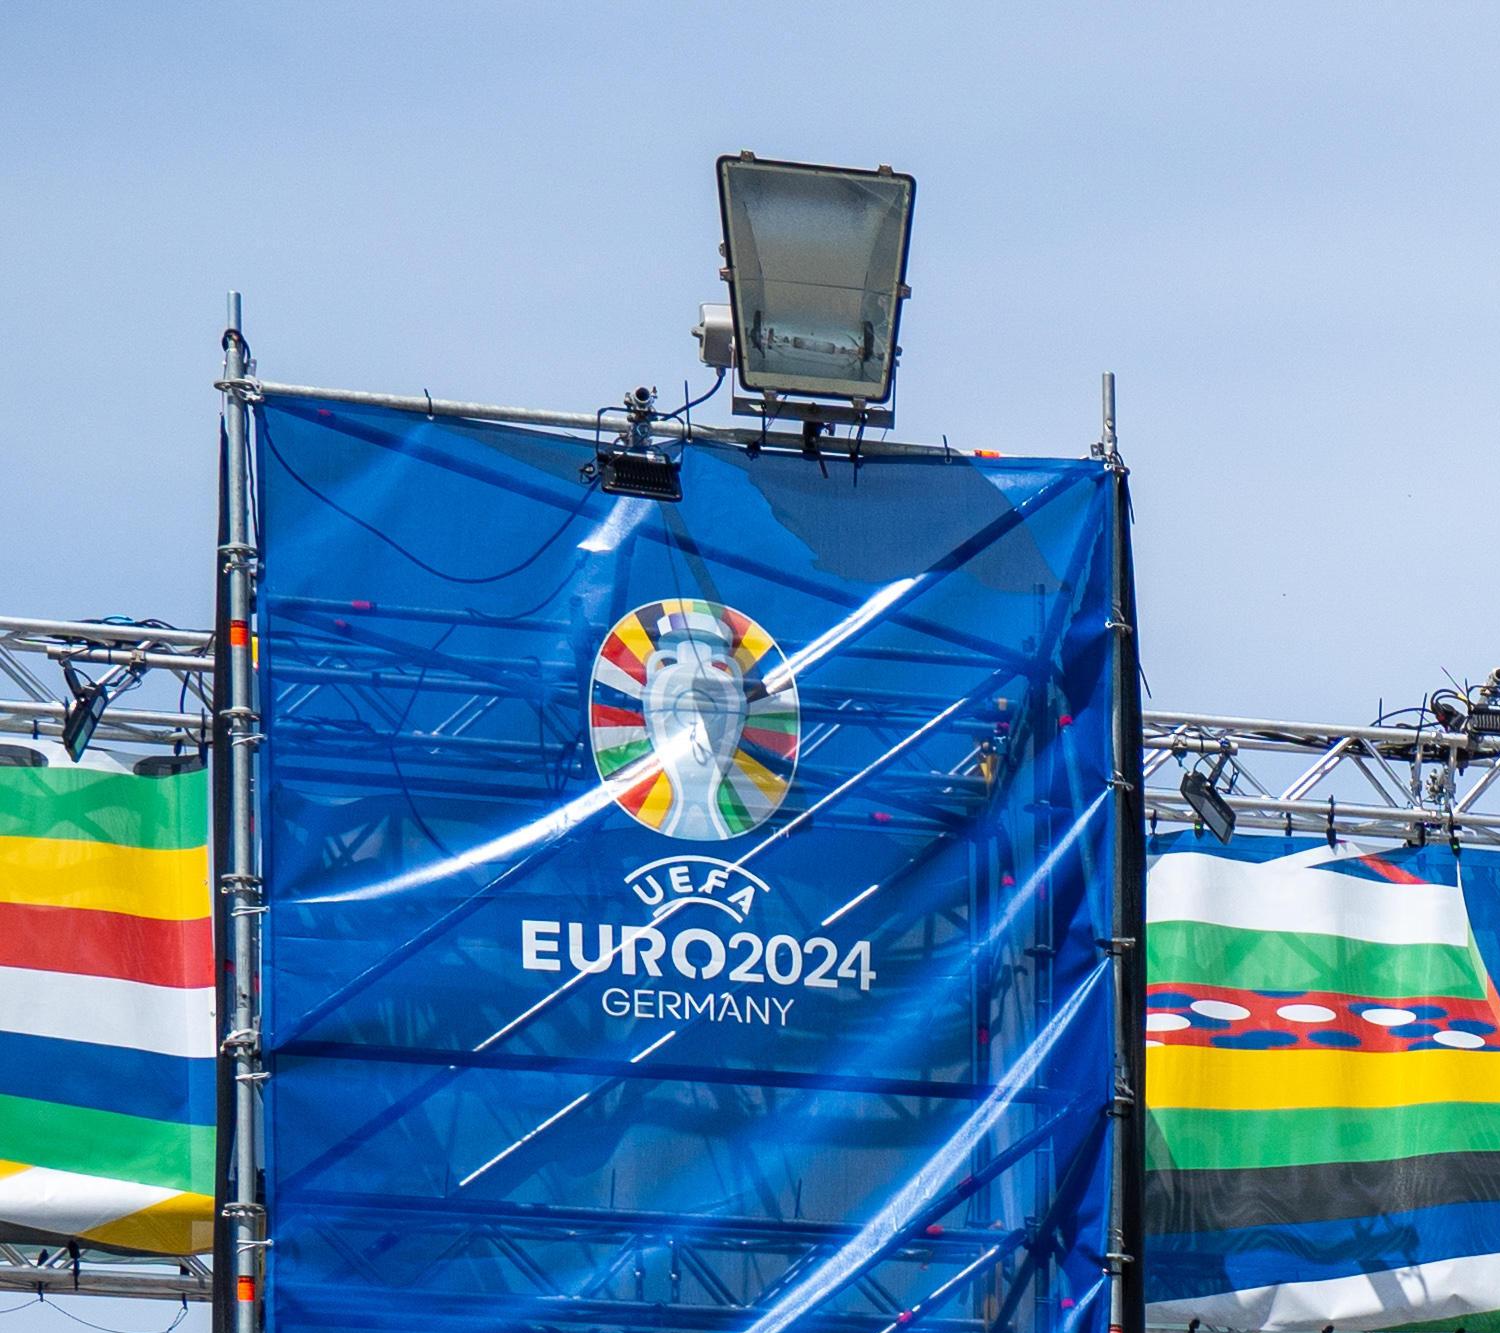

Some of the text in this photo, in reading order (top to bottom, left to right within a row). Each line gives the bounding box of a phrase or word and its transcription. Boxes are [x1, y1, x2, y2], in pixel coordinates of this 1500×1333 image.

[632, 866, 757, 916] UEFA
[521, 919, 877, 991] EURO2024
[602, 986, 795, 1026] GERMANY
